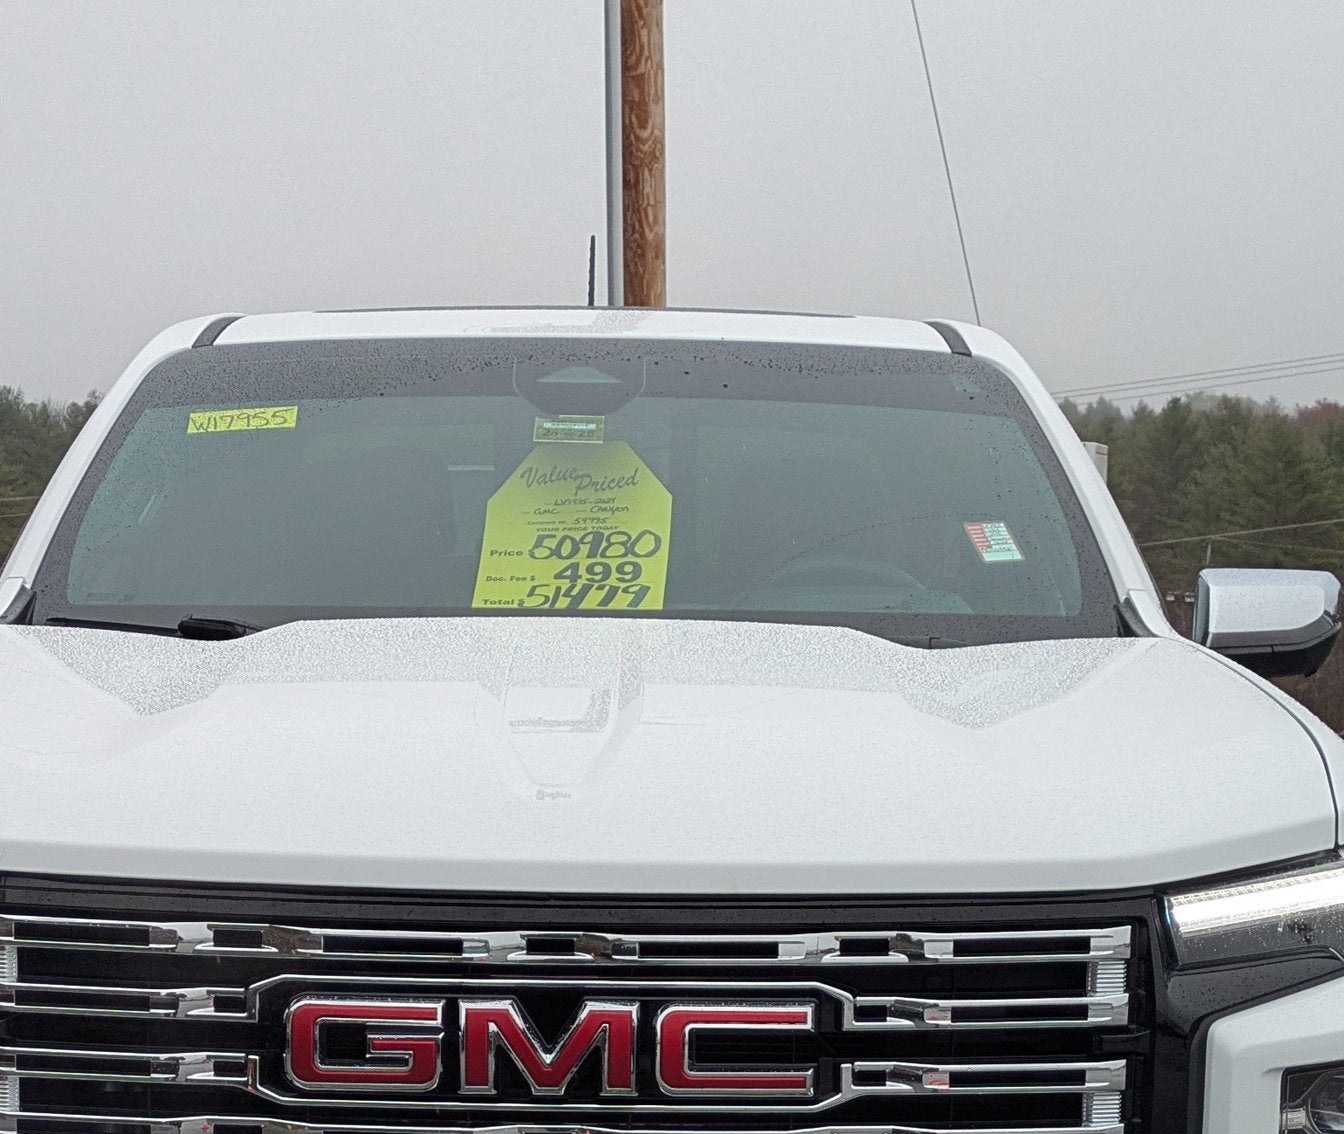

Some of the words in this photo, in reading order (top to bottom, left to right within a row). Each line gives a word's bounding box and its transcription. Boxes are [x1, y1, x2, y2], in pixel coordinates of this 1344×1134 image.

[191, 408, 295, 431] W17955
[520, 465, 578, 488] Value
[574, 467, 639, 496] Priced
[489, 549, 523, 557] Price
[531, 529, 662, 560] 50980
[553, 560, 643, 583] 499
[482, 598, 515, 606] Total
[525, 583, 652, 609] 51479
[284, 998, 817, 1096] GMC
